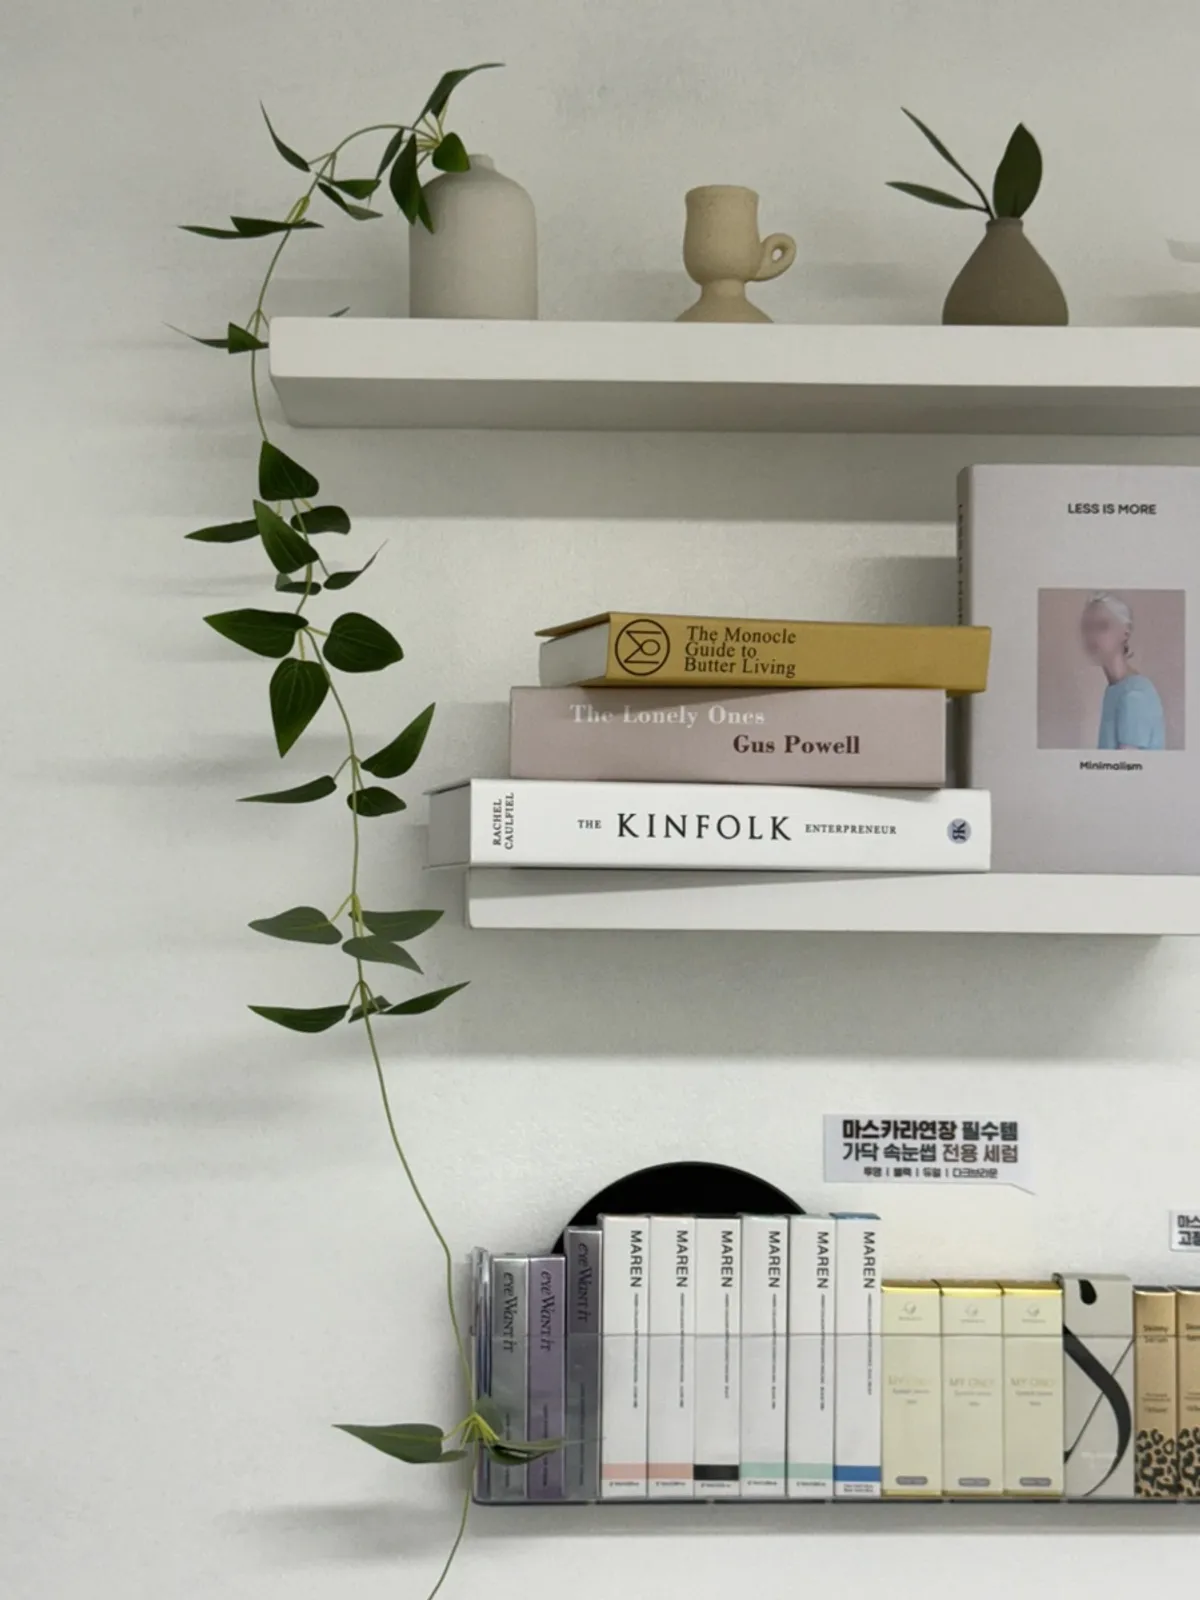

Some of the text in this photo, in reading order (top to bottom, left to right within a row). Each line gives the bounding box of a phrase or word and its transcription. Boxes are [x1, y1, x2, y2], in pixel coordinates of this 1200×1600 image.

[1067, 502, 1157, 515] LESS IS MORE
[686, 625, 797, 644] The Monocle
[685, 642, 758, 659] Guide to
[684, 657, 797, 678] Butter Living
[570, 704, 766, 729] The Lonely Ones
[733, 734, 861, 754] Gus Powell
[1079, 760, 1143, 771] Minimalism
[492, 799, 503, 846] RACHEL
[504, 792, 515, 850] CAULFIEL
[577, 812, 897, 842] THE KINFOLK ENTERPRENEUR
[842, 1119, 1019, 1142] 마스카라연장 필수템
[842, 1142, 1018, 1163] 가닥 속눈썹 전용 세럼
[630, 1229, 643, 1288] MAREN
[676, 1229, 689, 1288] MAREN
[720, 1229, 733, 1288] MAREN
[768, 1230, 781, 1288] MAREN
[816, 1231, 829, 1289] MAREN
[863, 1231, 876, 1289] MAREN
